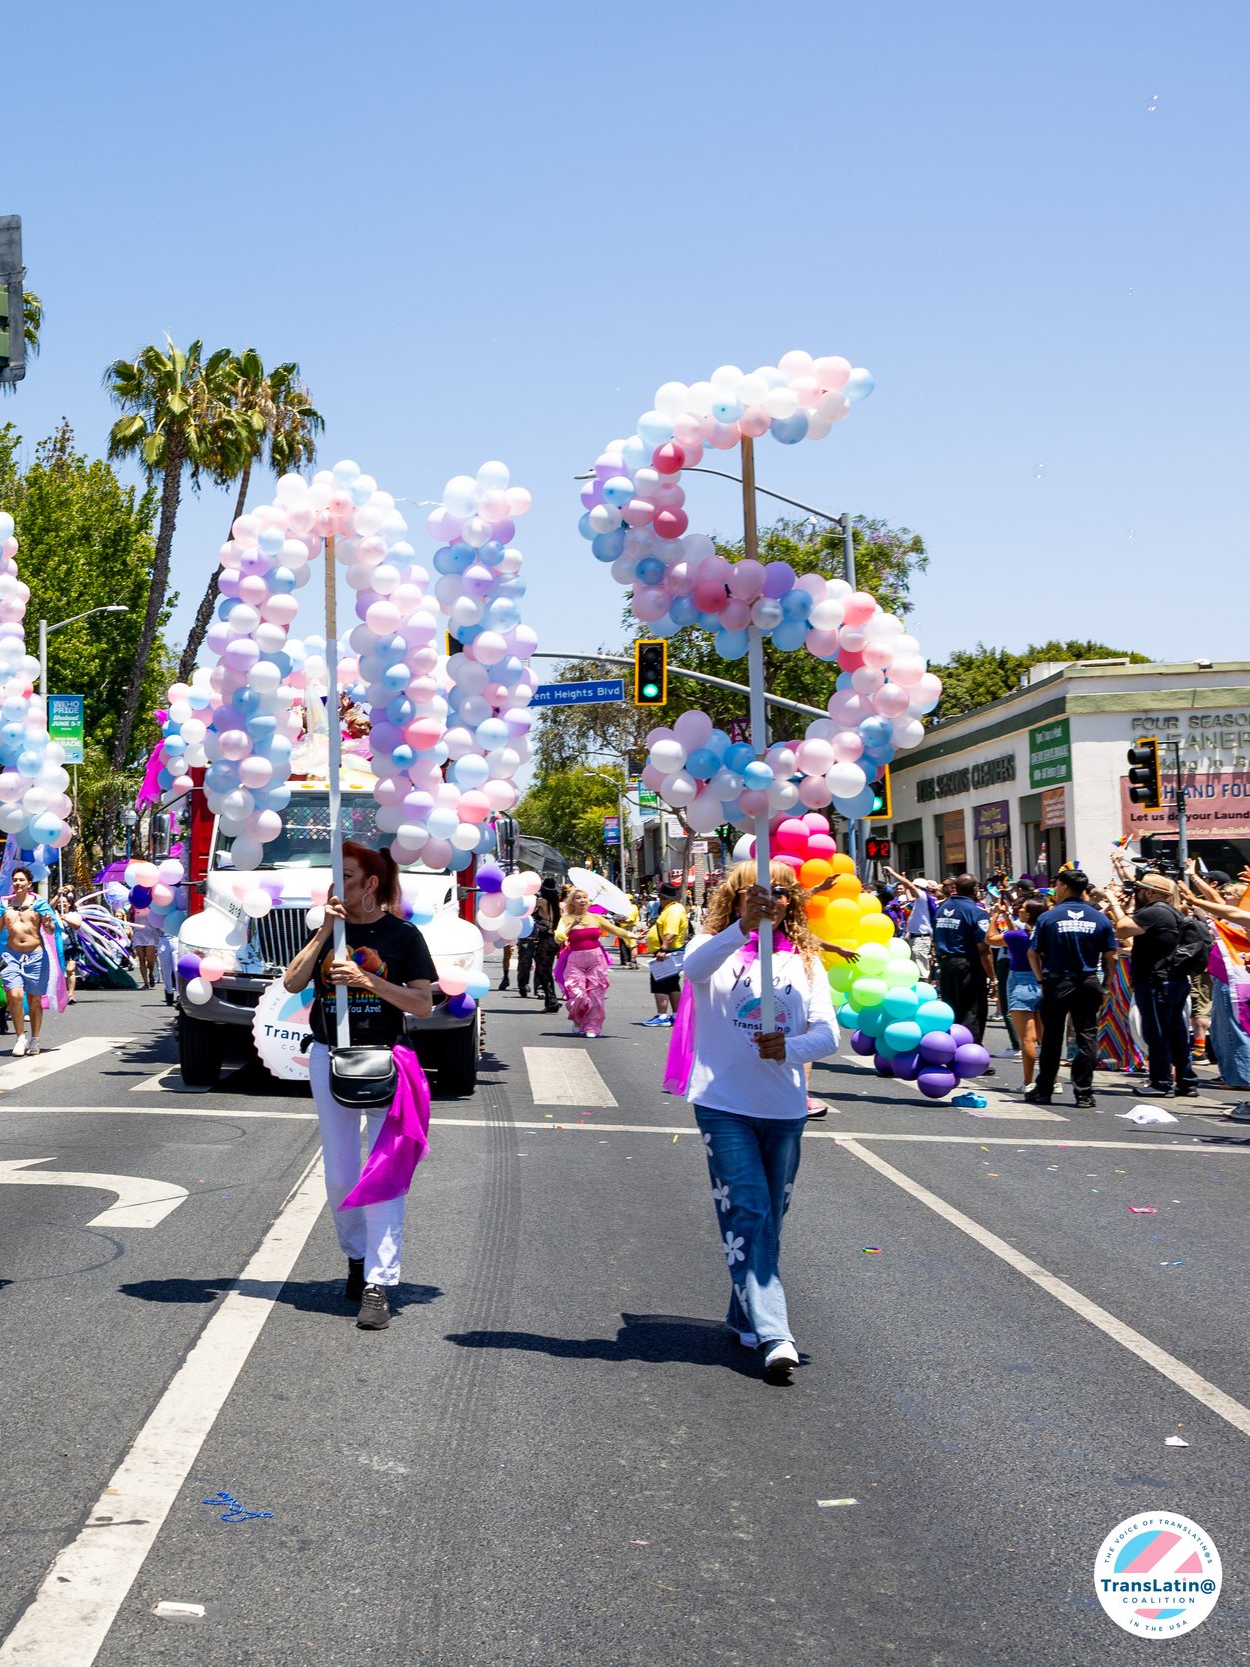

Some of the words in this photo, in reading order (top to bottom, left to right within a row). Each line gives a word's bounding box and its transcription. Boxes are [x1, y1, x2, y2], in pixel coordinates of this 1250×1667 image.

[554, 688, 594, 701] Heights
[597, 686, 621, 697] Blvd
[1132, 716, 1180, 731] FOUR
[1188, 713, 1250, 729] SEASO
[1181, 785, 1216, 799] AND
[1130, 813, 1149, 821] Let
[1186, 813, 1212, 822] your
